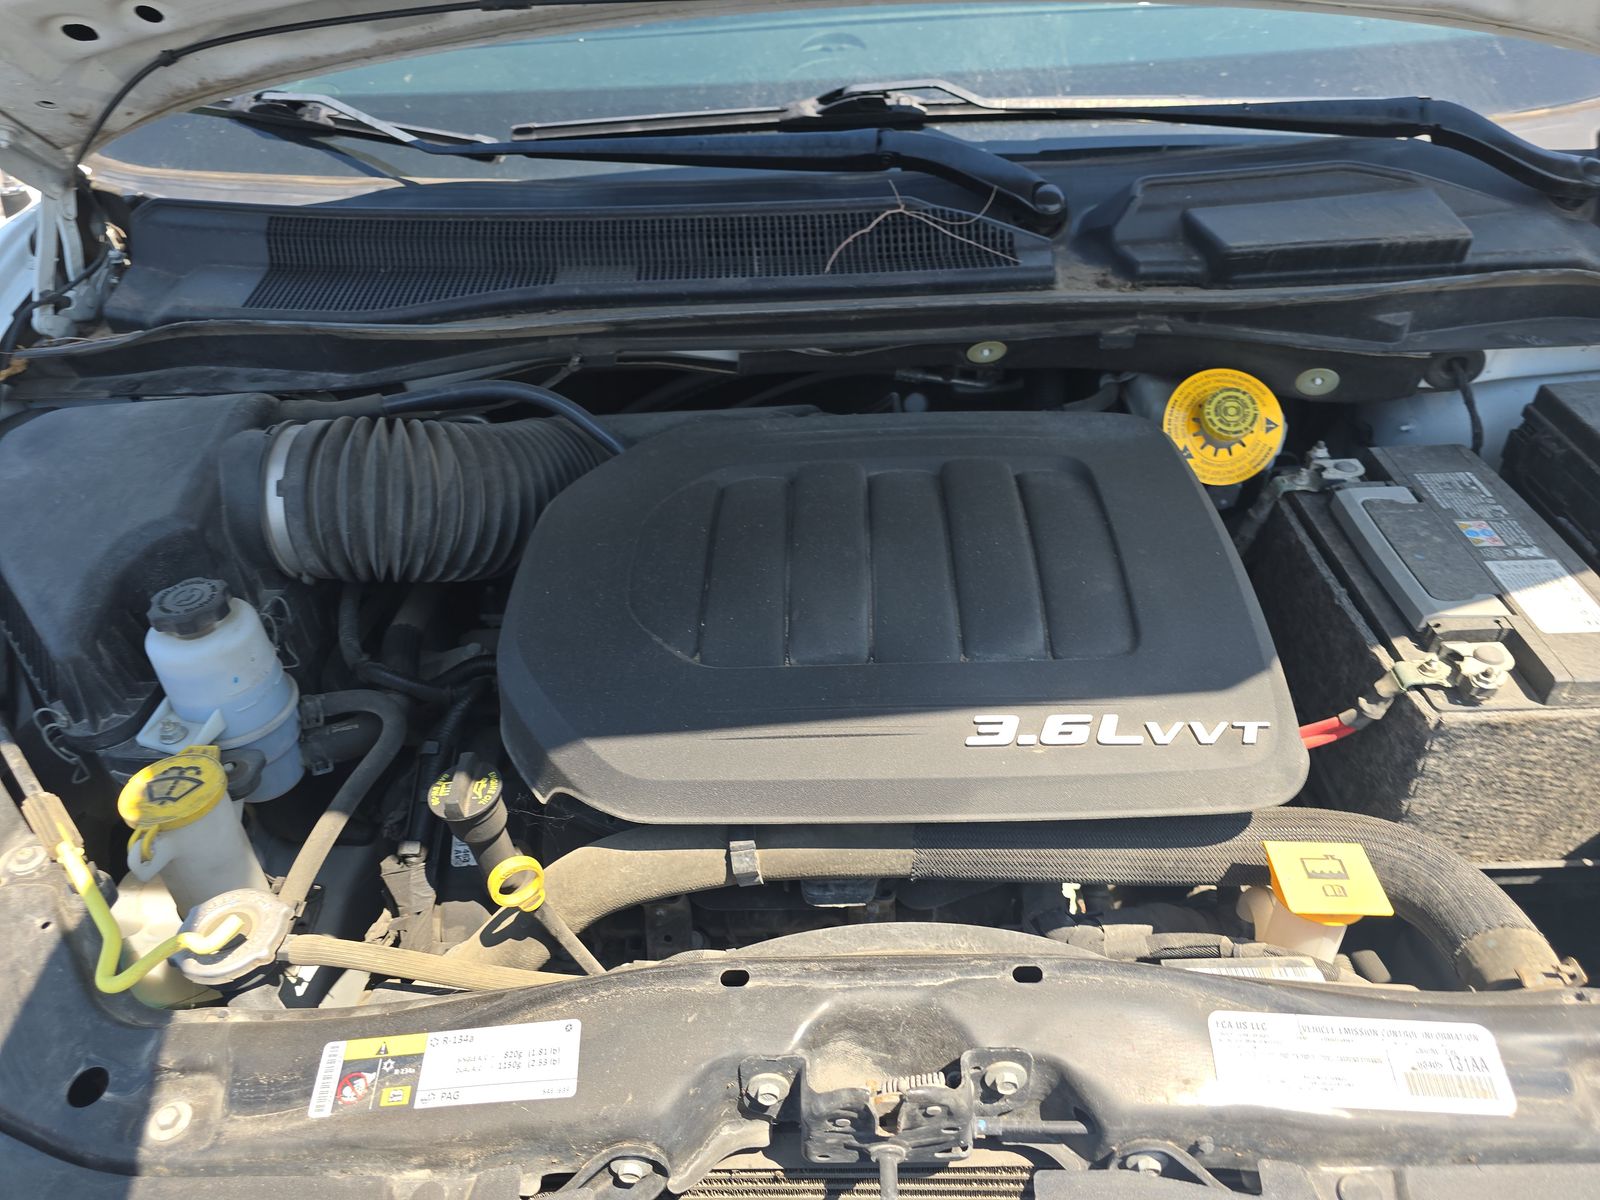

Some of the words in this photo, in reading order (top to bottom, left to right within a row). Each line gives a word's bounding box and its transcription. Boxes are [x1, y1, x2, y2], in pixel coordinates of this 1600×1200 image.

[965, 713, 1145, 748] 3.6L
[1144, 720, 1272, 746] VVT
[478, 794, 492, 805] OIL
[1301, 1024, 1336, 1035] VEHICLE
[1338, 1027, 1379, 1038] EMISSION
[442, 1034, 475, 1046] R-134a
[440, 1090, 460, 1101] PAG
